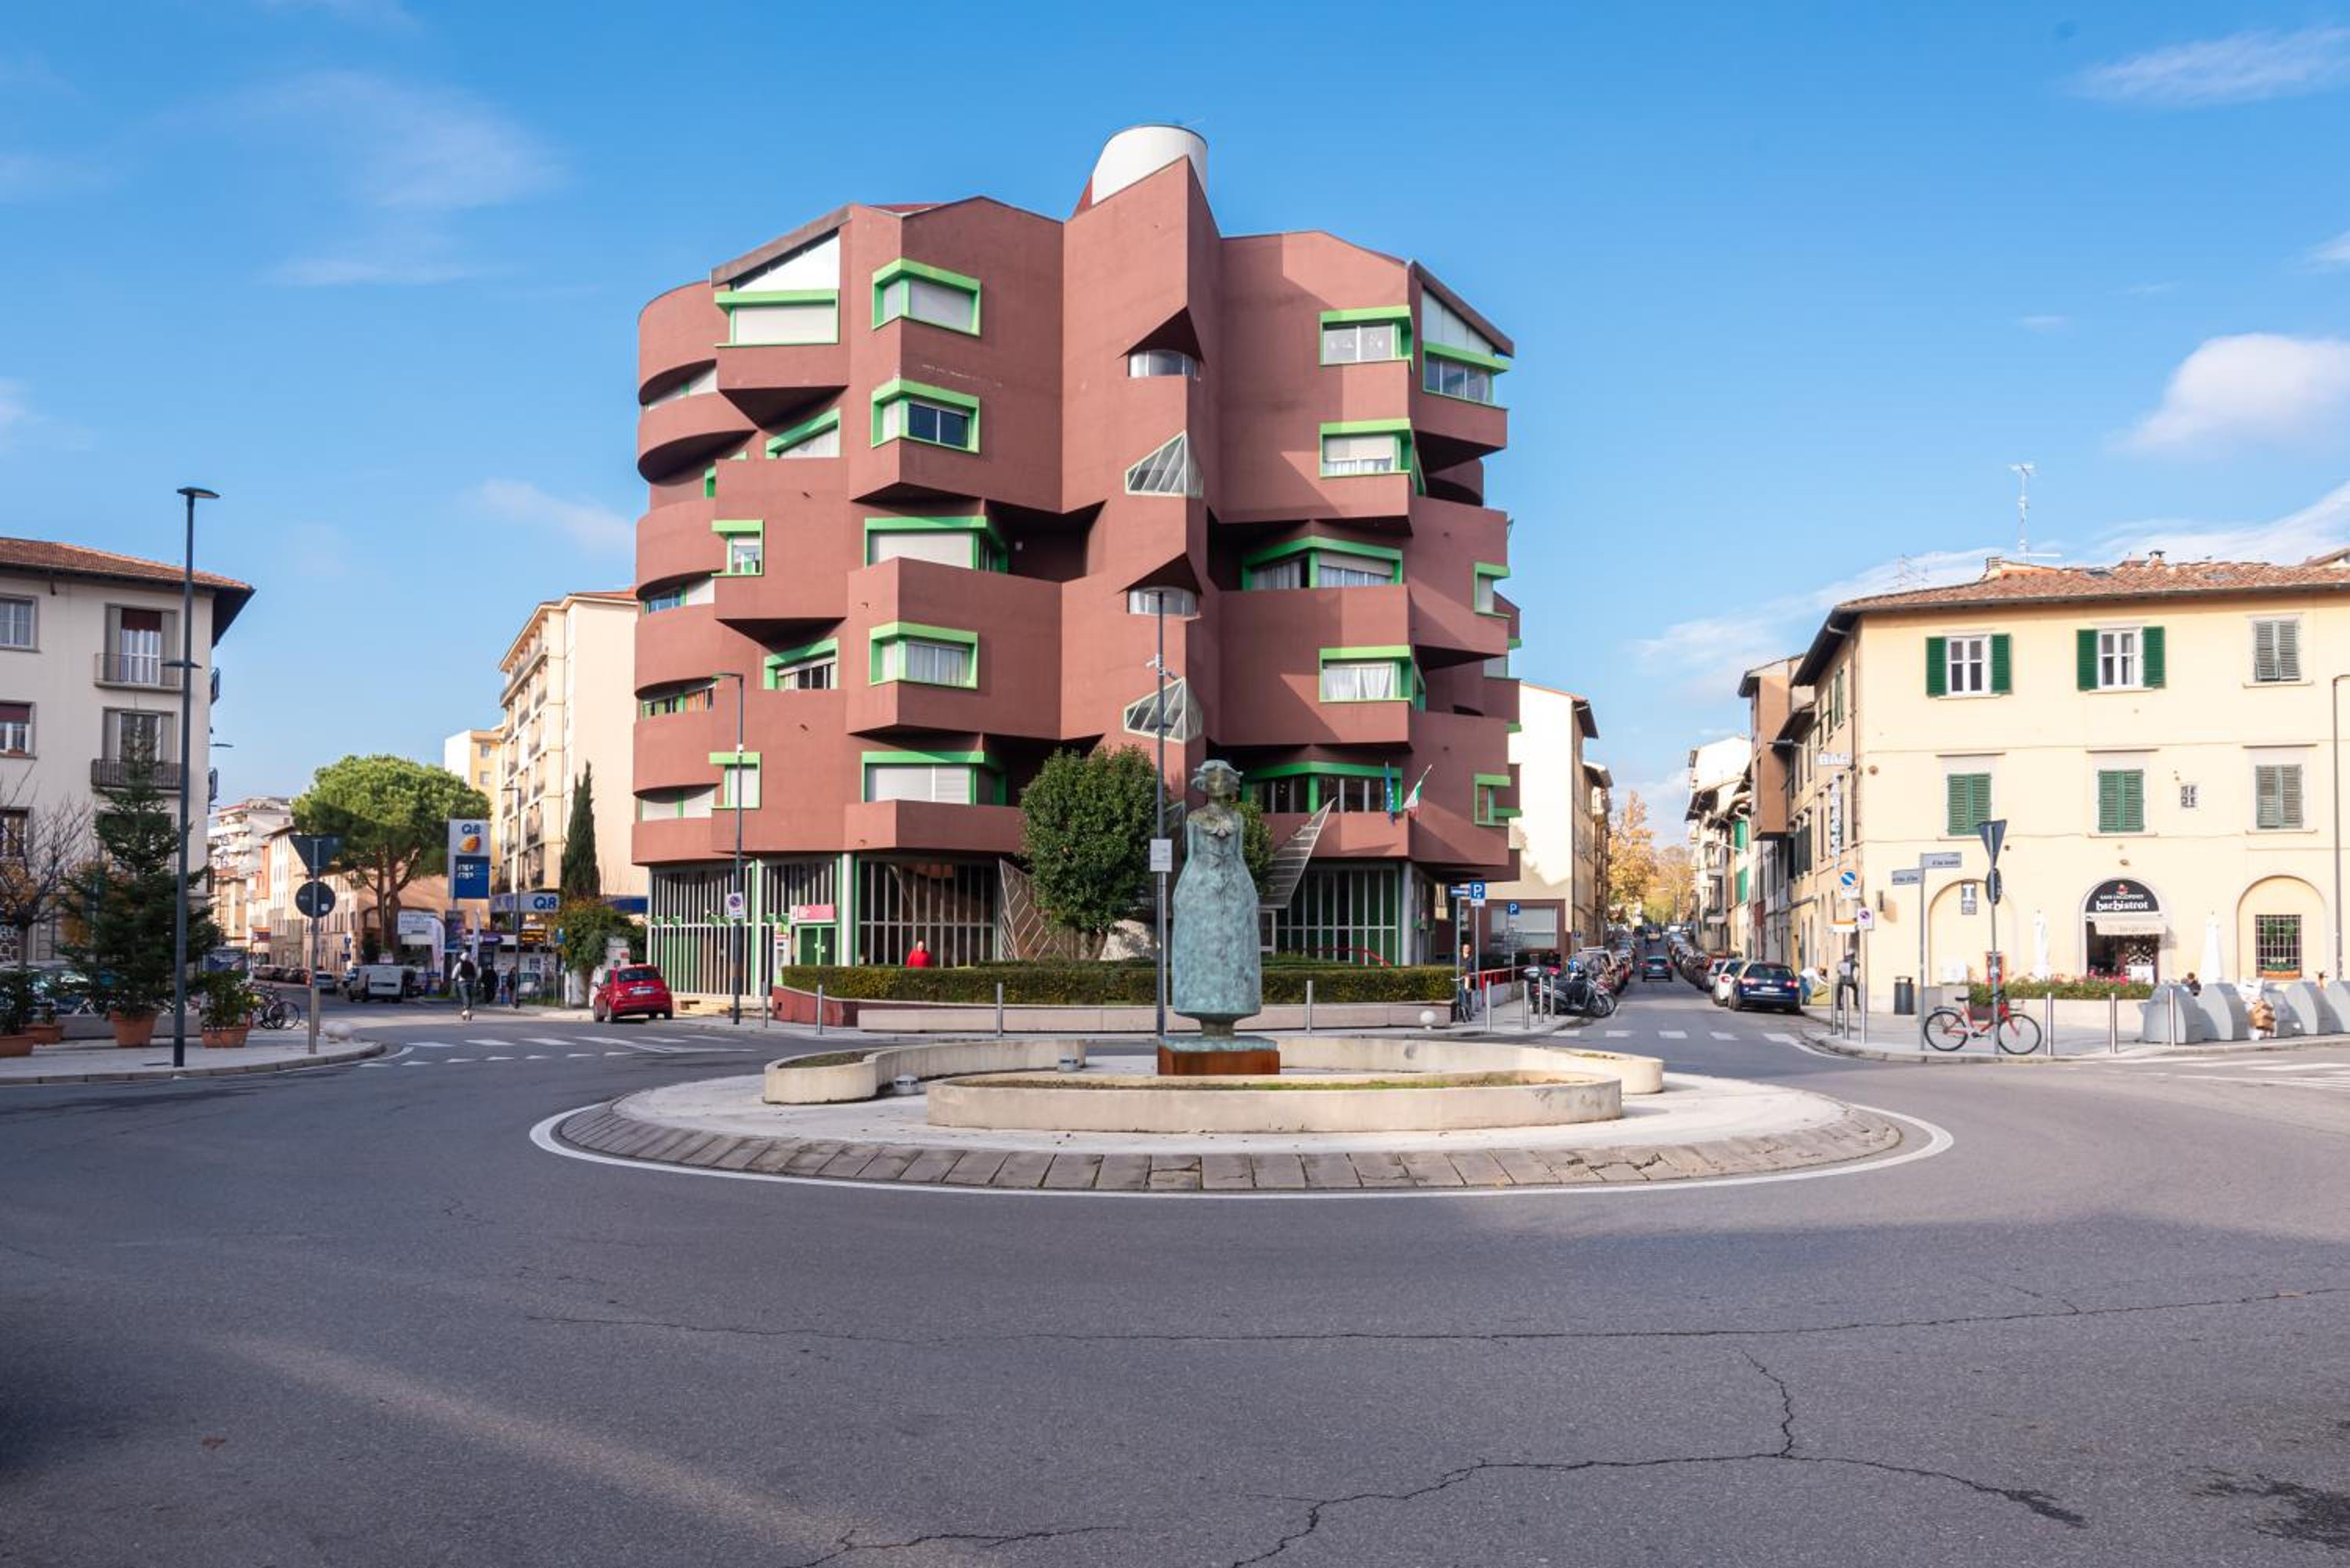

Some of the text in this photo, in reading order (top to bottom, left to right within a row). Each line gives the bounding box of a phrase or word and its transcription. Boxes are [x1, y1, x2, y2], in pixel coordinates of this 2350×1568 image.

[461, 823, 481, 836] Q8
[1473, 883, 1483, 897] P
[533, 896, 557, 909] Q8
[1509, 903, 1517, 914] P
